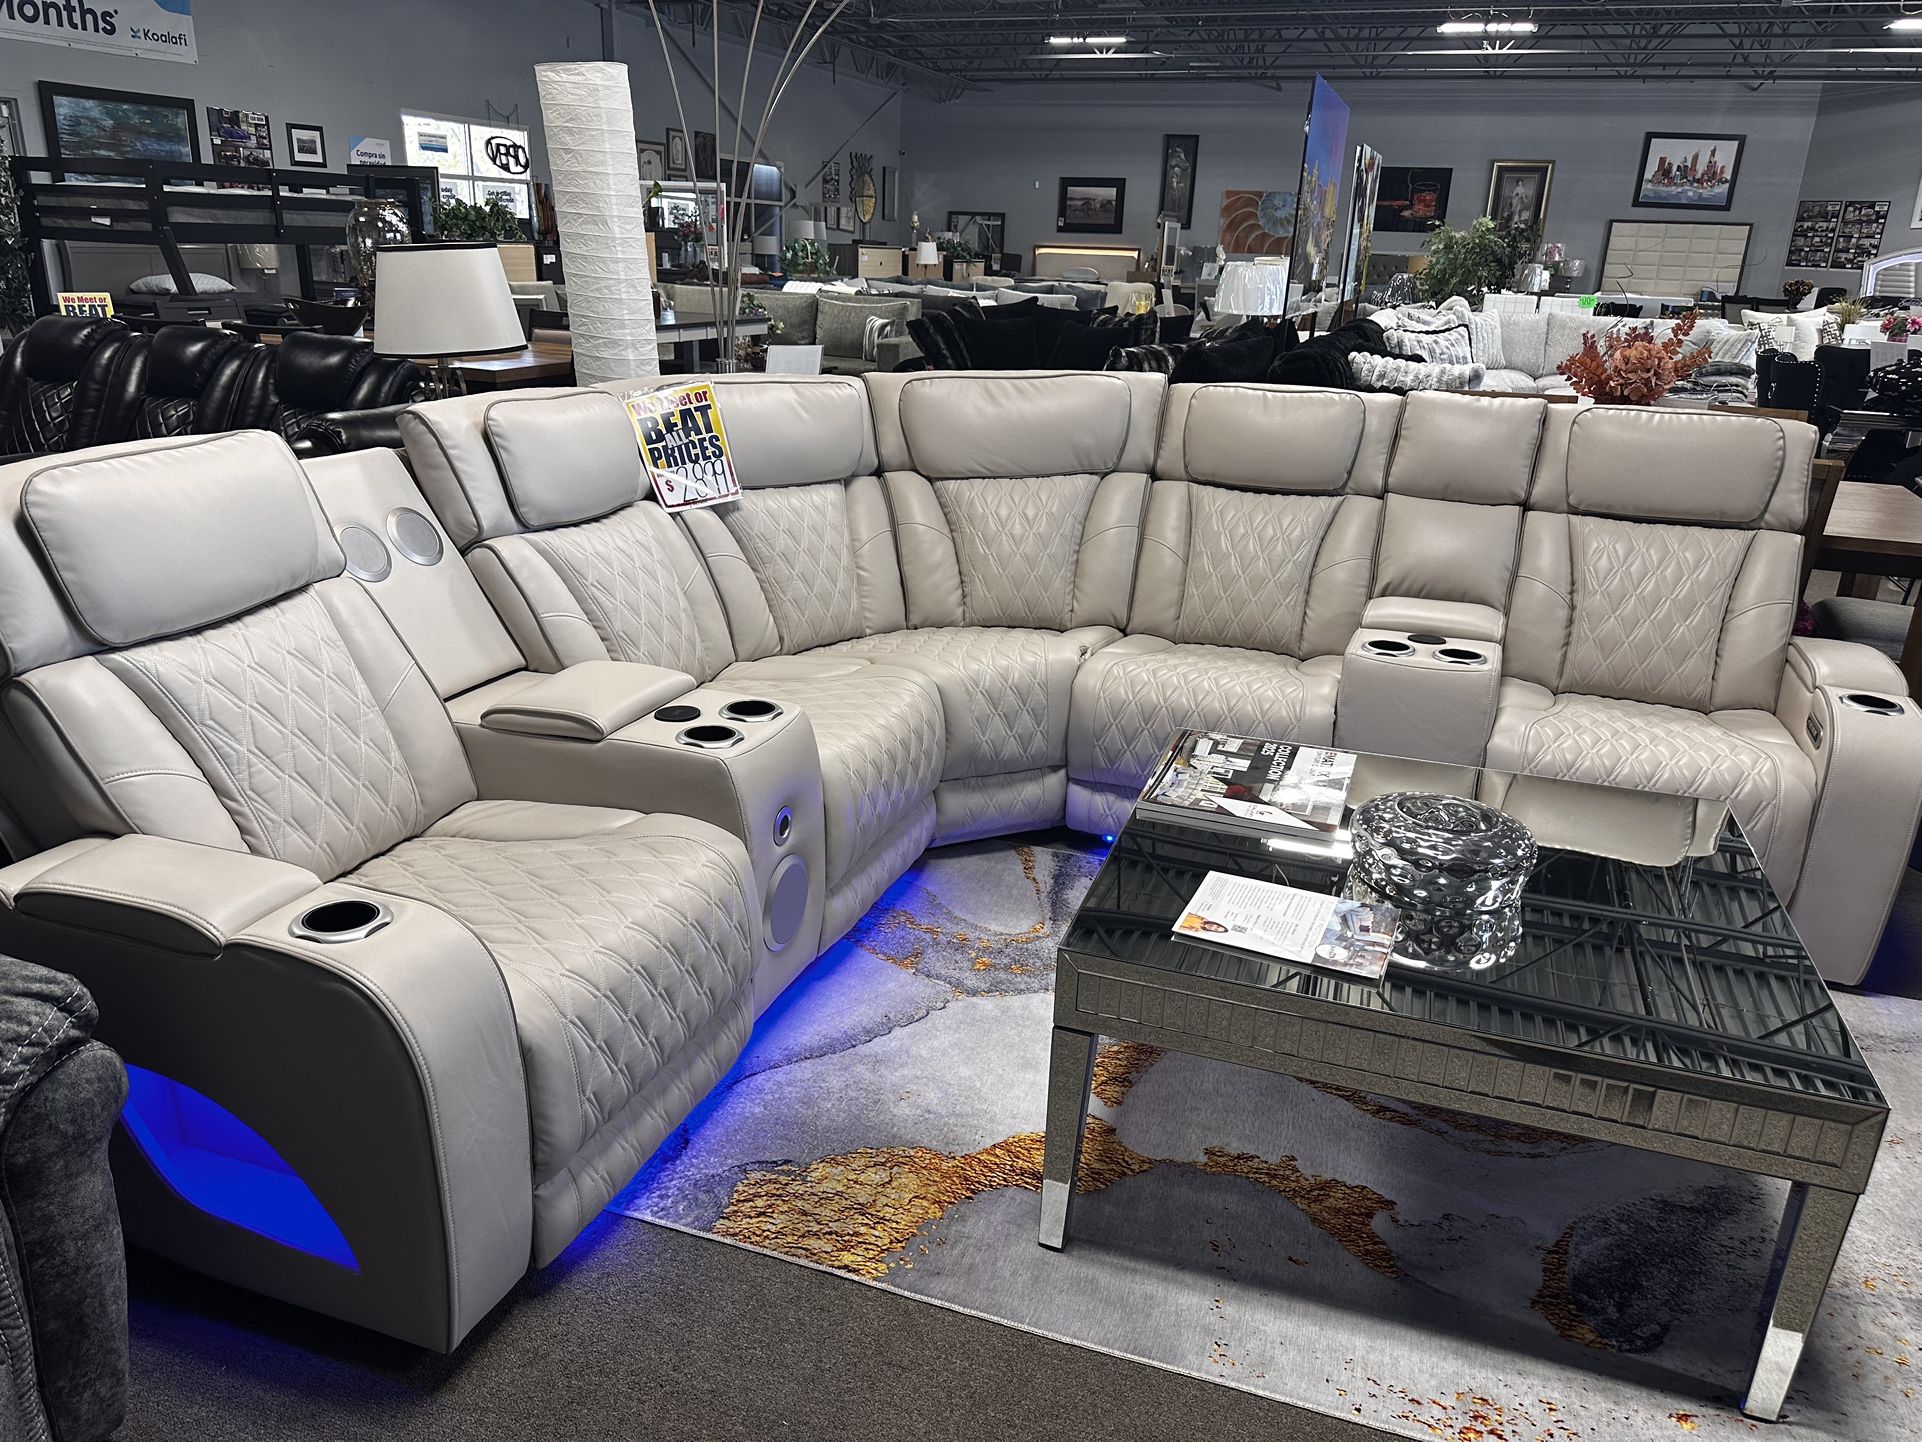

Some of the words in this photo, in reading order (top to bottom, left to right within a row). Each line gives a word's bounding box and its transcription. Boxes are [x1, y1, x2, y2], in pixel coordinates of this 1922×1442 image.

[143, 28, 188, 46] Koalafi
[356, 149, 378, 159] Compra
[62, 296, 77, 304] We
[77, 296, 98, 304] Meet
[64, 304, 108, 318] BEAT
[694, 390, 708, 403] or
[637, 404, 714, 446] BEAT
[664, 430, 690, 448] ALL
[648, 434, 724, 470] PRICES
[1260, 743, 1279, 756] 2025
[1265, 745, 1293, 781] COLLECTION
